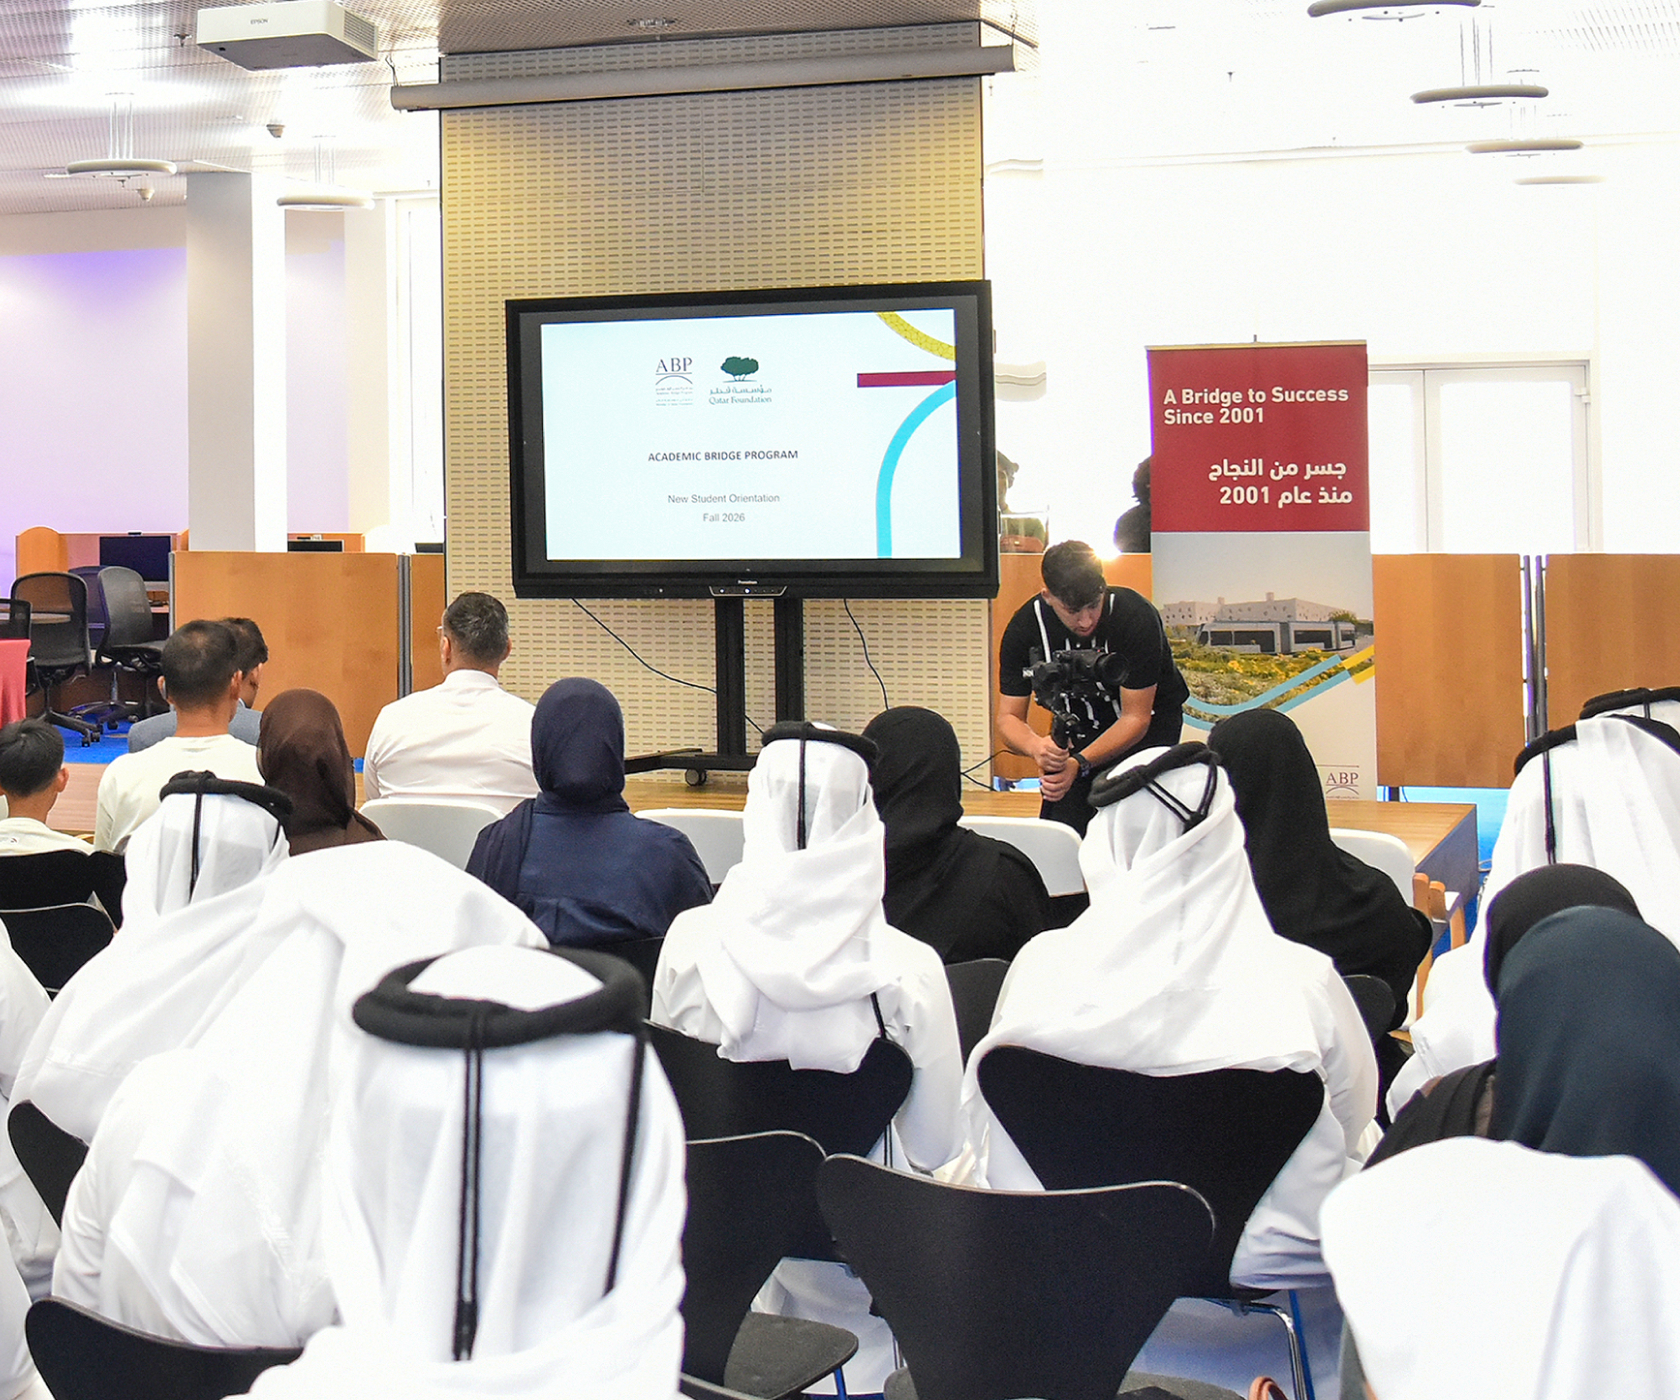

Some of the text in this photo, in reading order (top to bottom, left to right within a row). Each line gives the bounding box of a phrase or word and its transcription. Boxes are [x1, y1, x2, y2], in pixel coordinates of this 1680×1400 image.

[656, 357, 693, 372] ABP
[709, 396, 773, 405] Qatar Foundation
[1163, 386, 1349, 406] A Bridge to Success
[1164, 407, 1264, 424] Since 2001
[648, 450, 799, 462] ACADEMIC BRIDGE PROGRAM
[1208, 458, 1347, 481] جسر من النجاح
[667, 493, 780, 503] New Student Orientation
[1219, 486, 1353, 508] منذ عام 2001
[702, 512, 746, 522] Fall 2026
[1326, 771, 1359, 784] ABP
